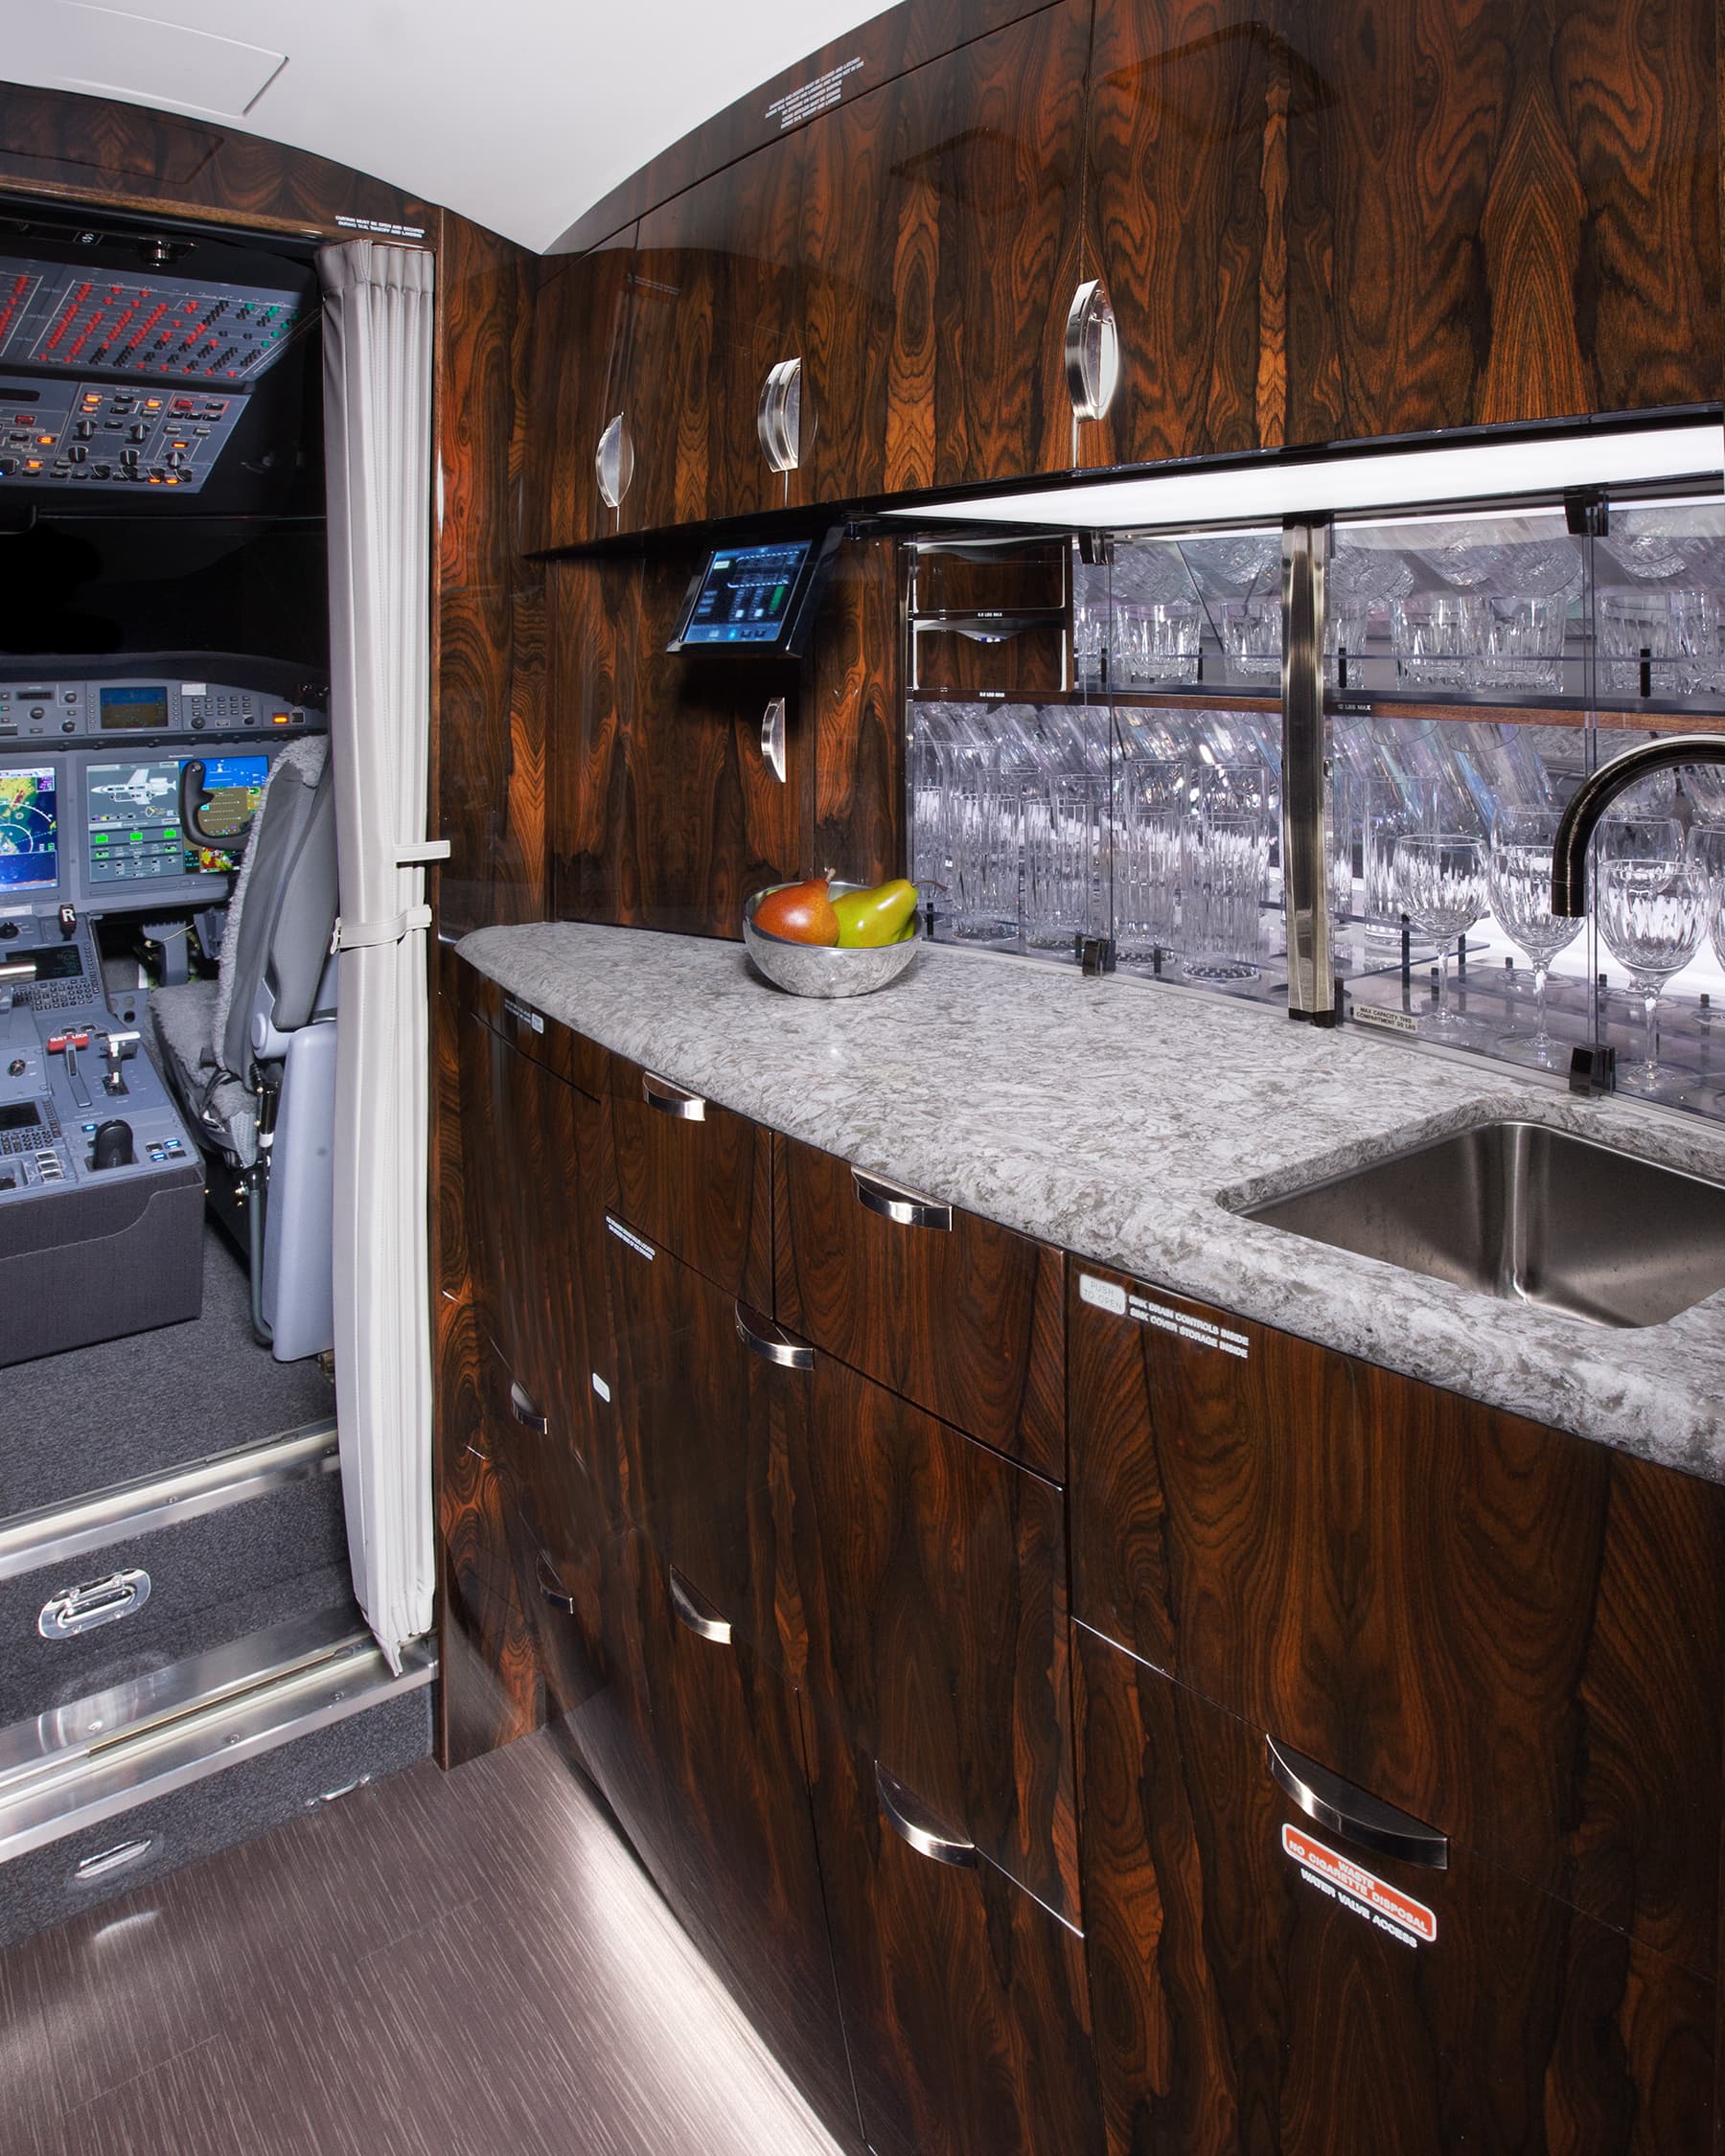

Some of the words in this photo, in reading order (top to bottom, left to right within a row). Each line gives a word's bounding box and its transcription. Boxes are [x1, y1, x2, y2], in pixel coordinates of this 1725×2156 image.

[62, 908, 76, 922] R
[1356, 1012, 1395, 1025] COMPARTMENT
[1360, 1006, 1371, 1015] MAX
[1373, 1010, 1397, 1020] CAPACITY
[1399, 1016, 1412, 1024] THIS
[1083, 1288, 1094, 1299] TO
[1098, 1295, 1121, 1310] OPEN
[1091, 1281, 1114, 1296] PUSH
[1128, 1295, 1147, 1309] SINK
[1148, 1301, 1174, 1318] DRAIN
[1175, 1312, 1220, 1335] CONTROLS
[1220, 1328, 1249, 1346] INSIDE
[1129, 1307, 1148, 1321] SINK
[1150, 1315, 1178, 1333] COVER
[1179, 1325, 1218, 1348] STORAGE
[1219, 1341, 1249, 1359] INSIDE
[1289, 1840, 1305, 1857] NO
[1308, 1852, 1368, 1895] CIGARETTE
[1371, 1890, 1428, 1933] DISPOSAL
[1338, 1860, 1375, 1891] WASTE
[1300, 1868, 1336, 1898] WATER
[1338, 1892, 1370, 1919] VALVE
[1372, 1915, 1418, 1948] ACCESS
